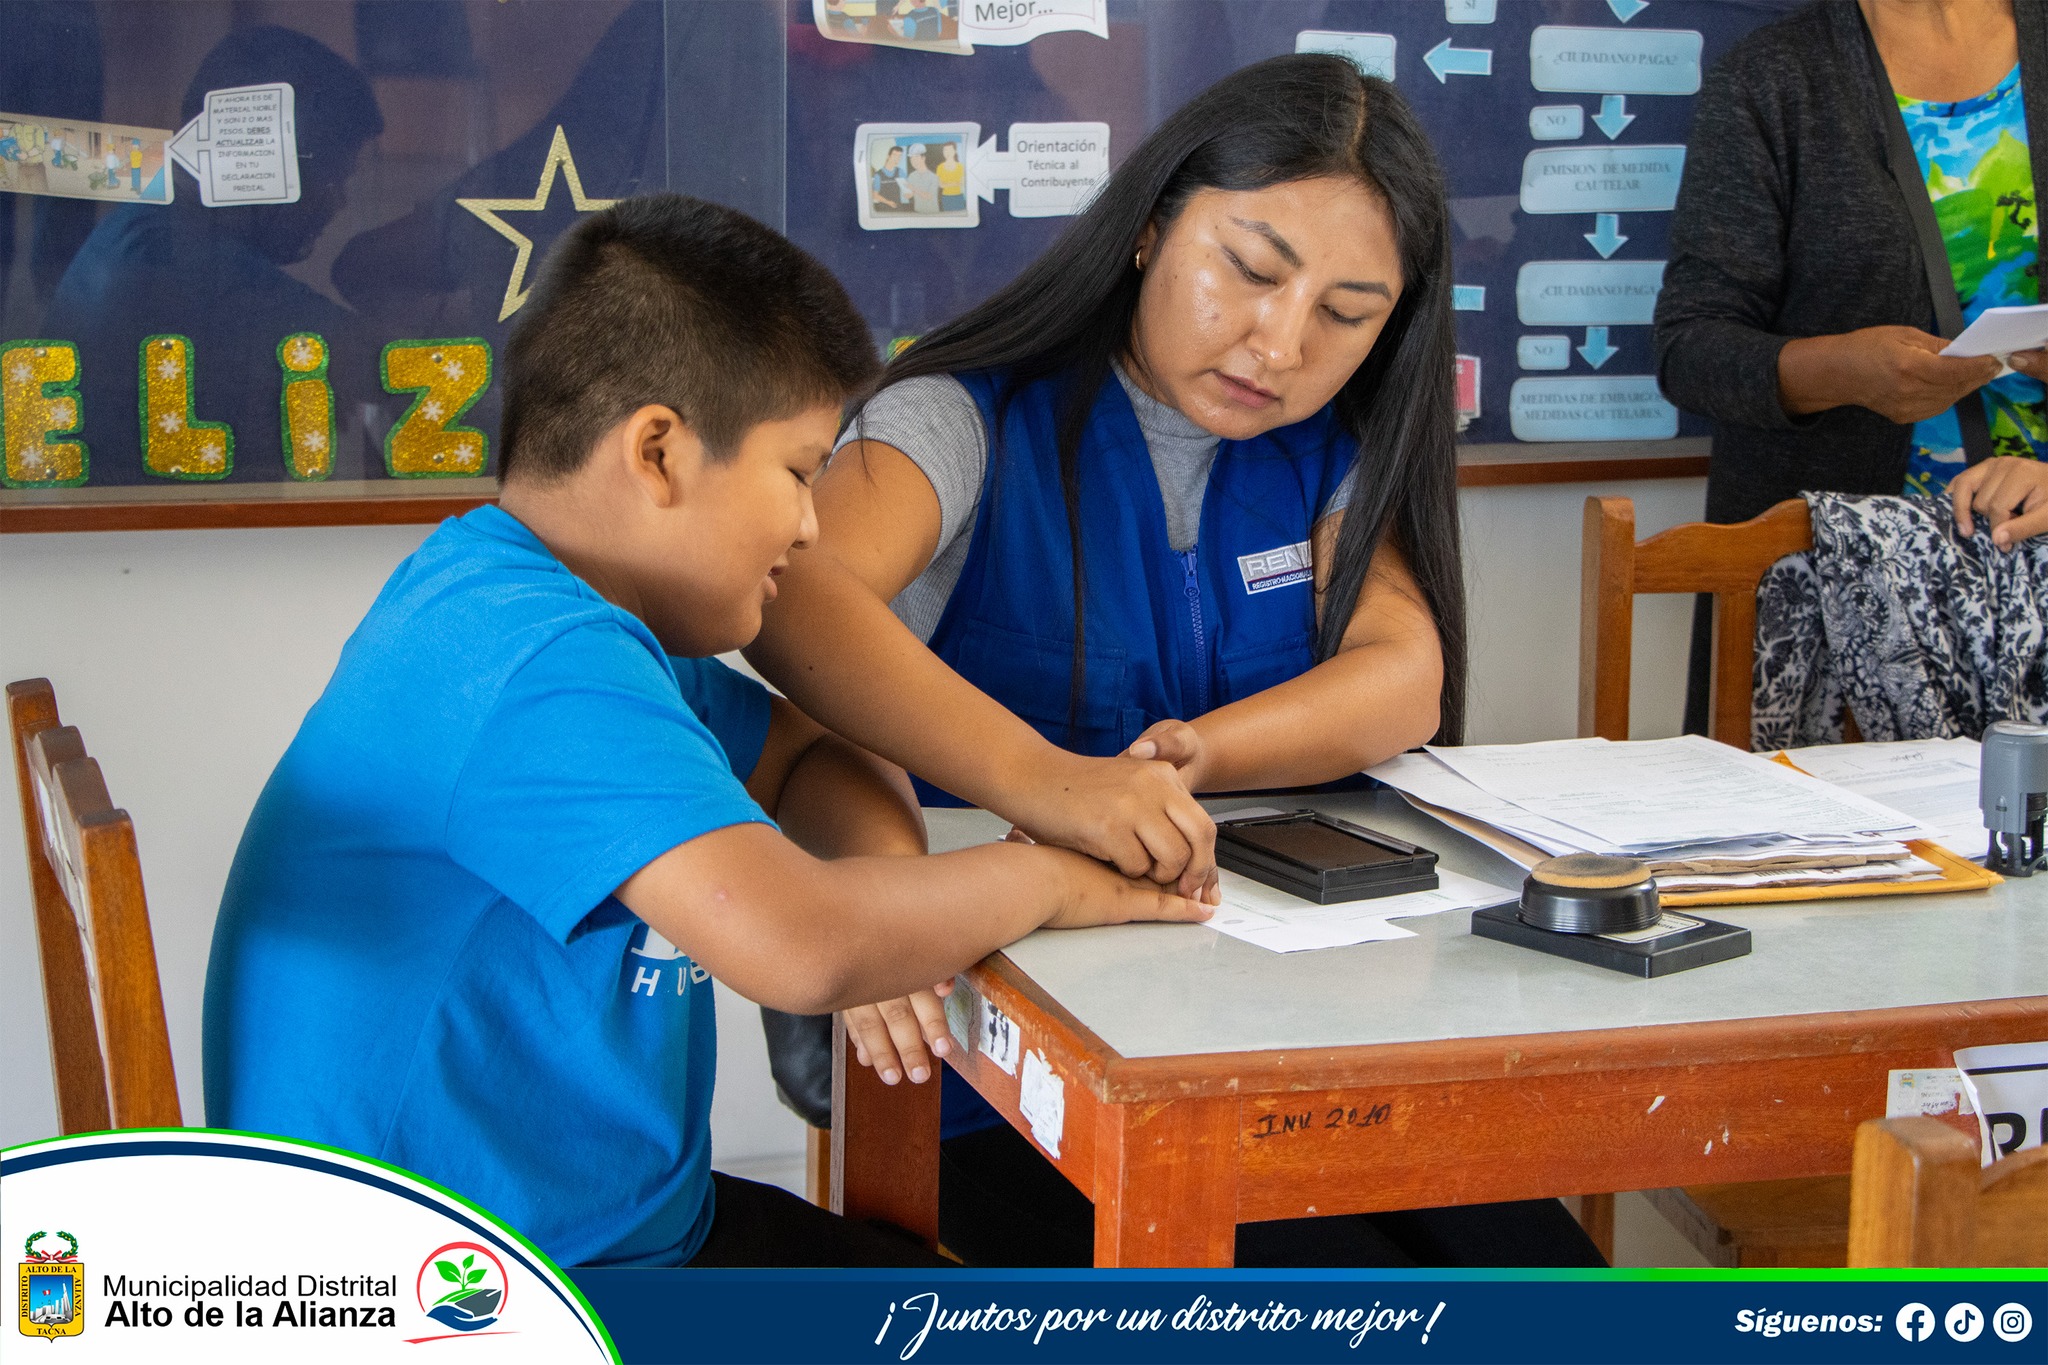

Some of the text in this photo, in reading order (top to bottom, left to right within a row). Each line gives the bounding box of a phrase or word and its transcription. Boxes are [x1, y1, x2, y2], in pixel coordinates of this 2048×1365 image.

[975, 0, 1053, 23] Mejor...
[213, 104, 278, 114] MATERIAL NOBLE
[1546, 115, 1566, 126] NO
[247, 126, 271, 136] DEBES
[216, 139, 265, 148] ACTUALIZAR
[1017, 139, 1096, 153] Orientación
[218, 150, 275, 158] INFORMACION
[236, 161, 259, 170] EN TU
[1028, 159, 1079, 171] Técnica al
[1543, 162, 1671, 176] EMISION DE MEDIDA
[221, 173, 275, 181] DECLARACION
[1021, 177, 1094, 188] Contribuyente
[1575, 180, 1640, 192] CAUTELAR
[1624, 284, 1659, 296] PAGA
[1534, 346, 1553, 356] NO
